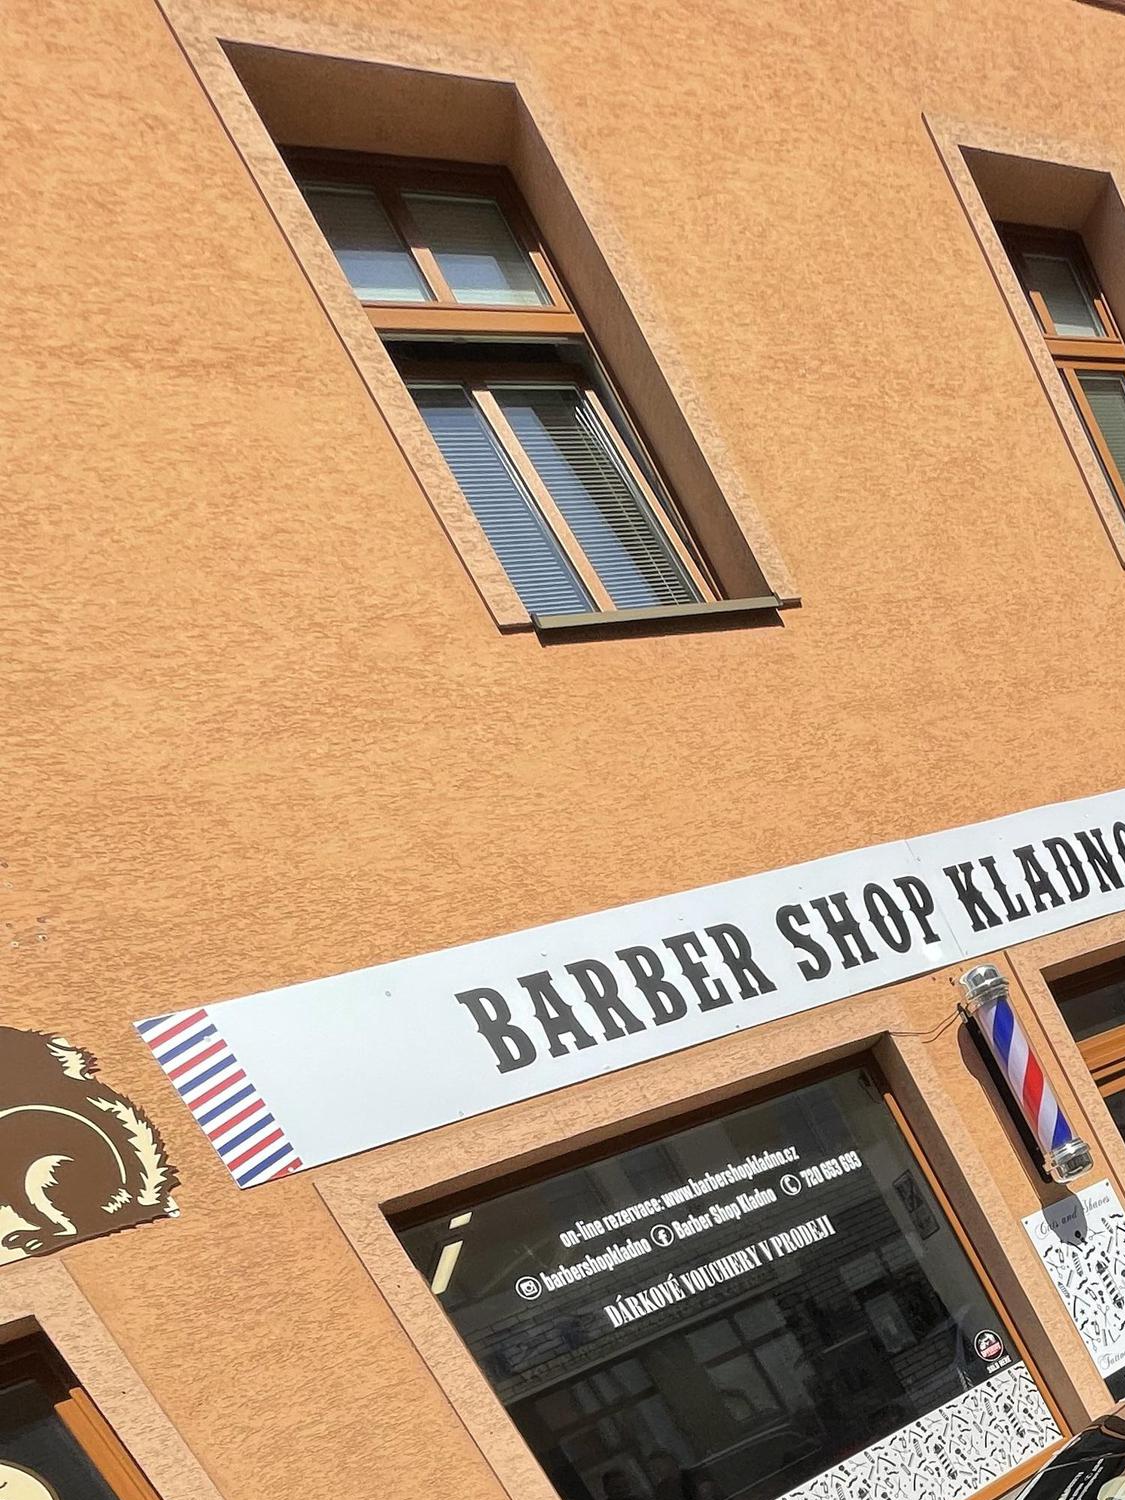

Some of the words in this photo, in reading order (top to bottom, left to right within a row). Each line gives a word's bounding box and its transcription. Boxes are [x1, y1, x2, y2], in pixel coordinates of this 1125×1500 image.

[454, 922, 778, 1074] BARBER
[775, 874, 941, 981] SHOP
[540, 1238, 652, 1292] barbershopkladno
[671, 1213, 714, 1239] Barber
[709, 1203, 741, 1224] Shop
[736, 1188, 777, 1214] Kladno
[800, 1170, 824, 1188] 720
[820, 1158, 843, 1180] 653
[839, 1150, 862, 1173] 693
[559, 1220, 605, 1248] on-line
[602, 1197, 665, 1231] rezervace:
[660, 1145, 799, 1209] www.barbershopkladno.cz
[1061, 1205, 1077, 1225] and
[1082, 1193, 1110, 1215] Shaves
[603, 1273, 687, 1328] DÁRKOVÉ
[680, 1245, 762, 1295] VOUCHERY
[757, 1240, 773, 1262] V
[768, 1214, 837, 1258] PRODEJI
